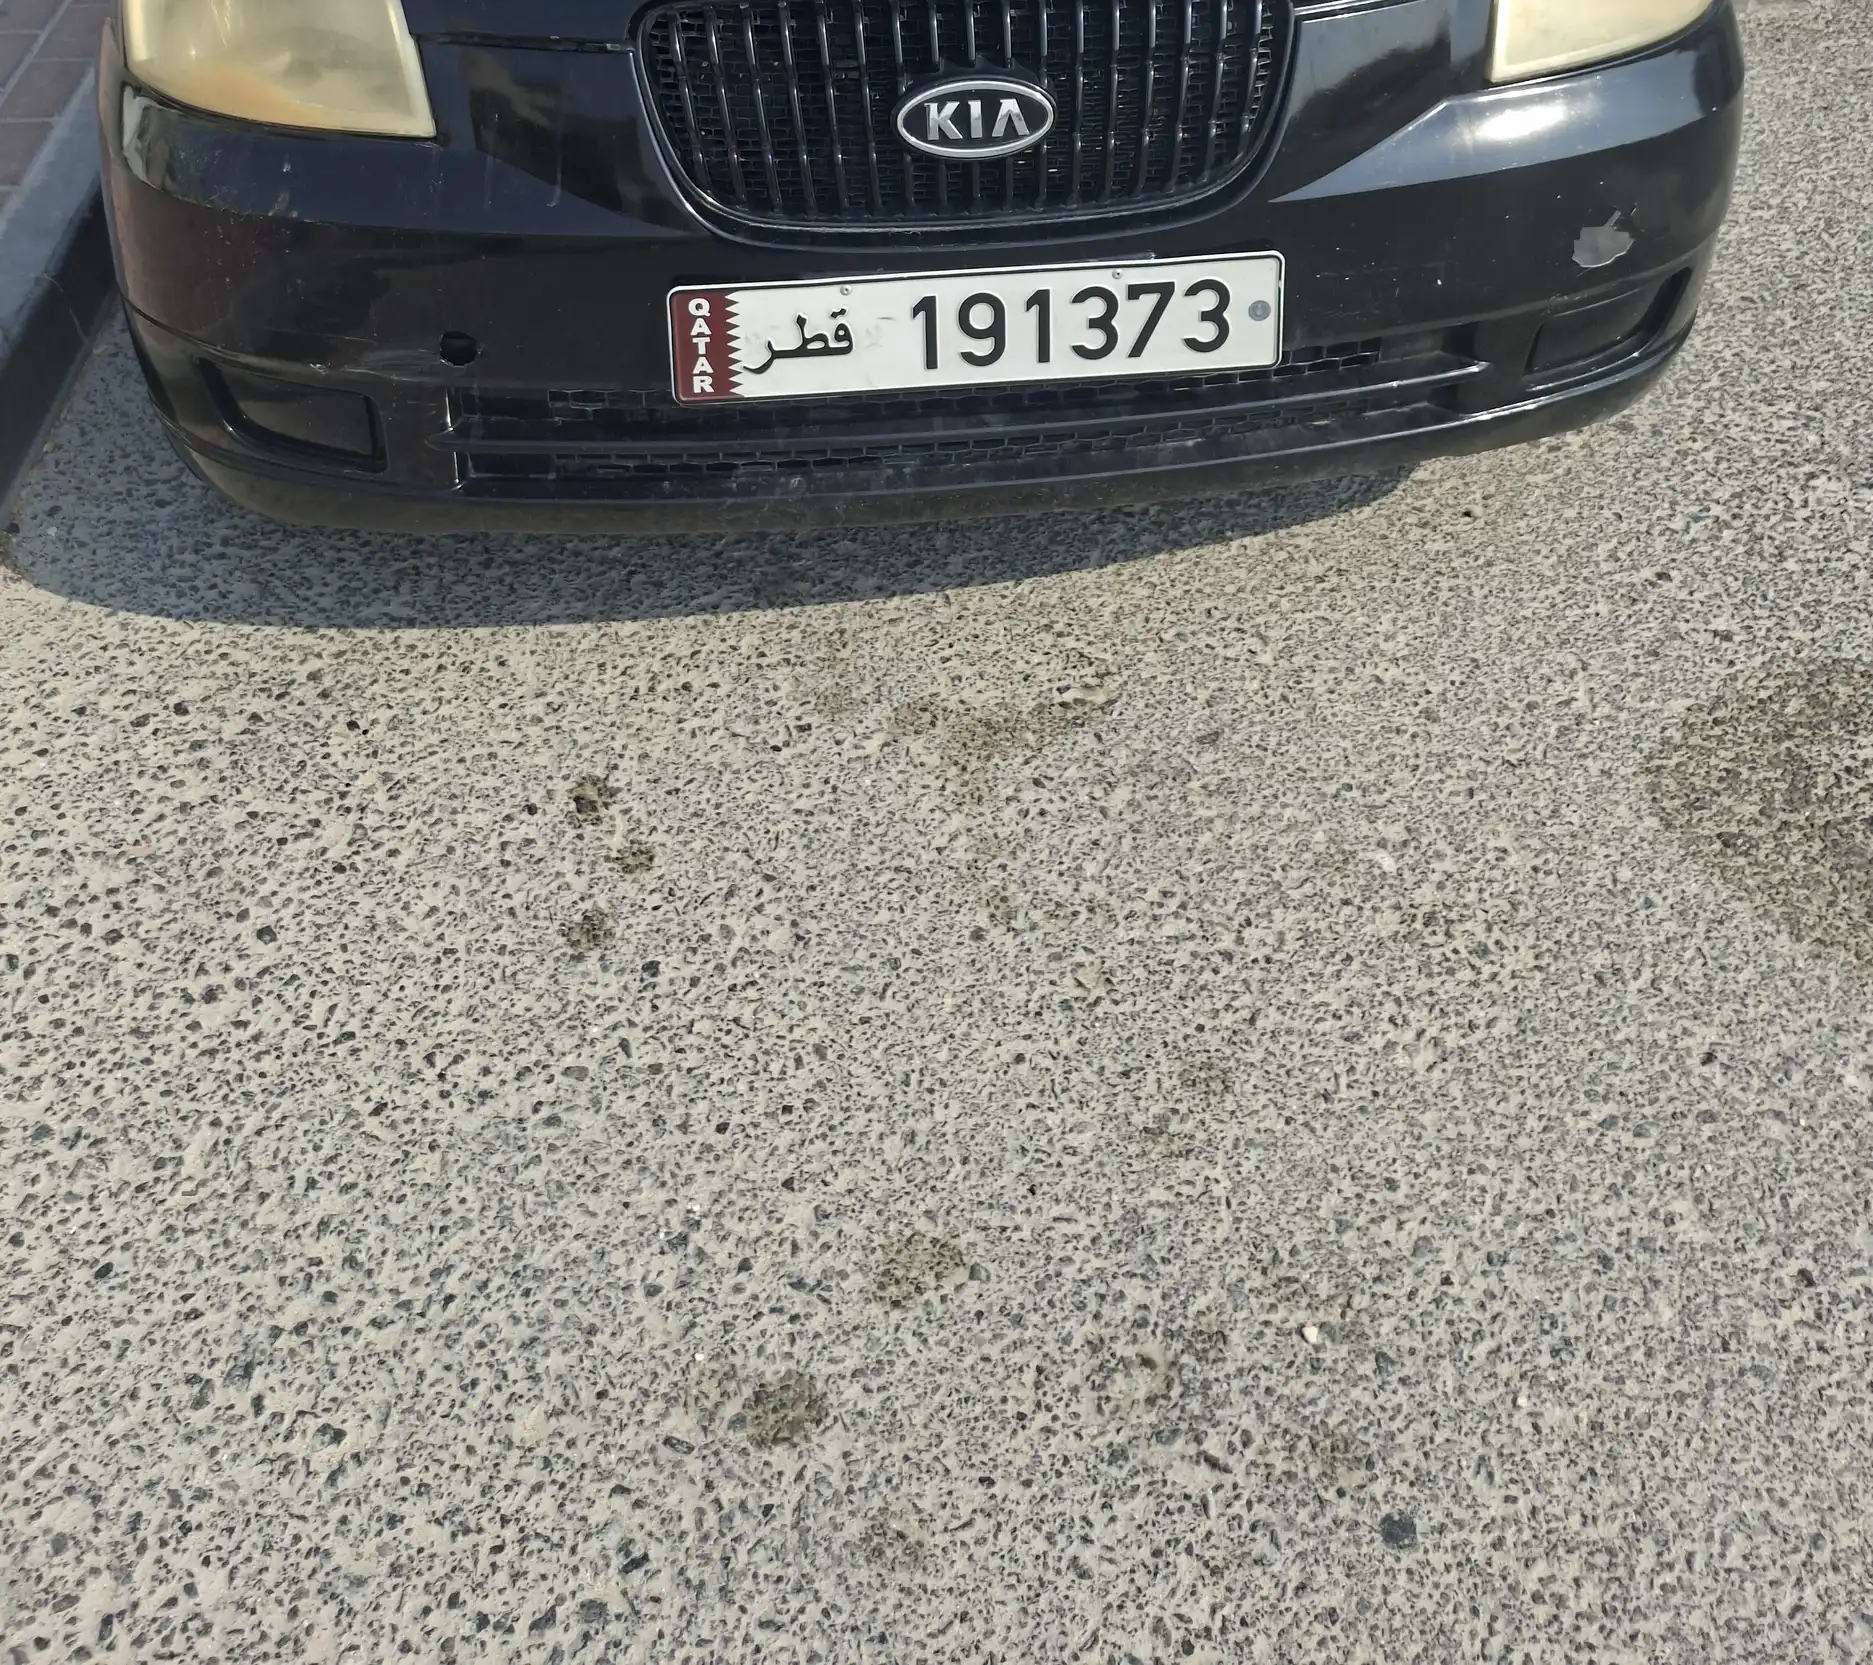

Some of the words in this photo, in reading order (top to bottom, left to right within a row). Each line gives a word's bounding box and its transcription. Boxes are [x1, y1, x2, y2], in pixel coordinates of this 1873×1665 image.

[923, 98, 1030, 141] KIA
[688, 297, 715, 394] QATAR
[742, 307, 854, 375] قطر
[911, 278, 1231, 371] 191373
